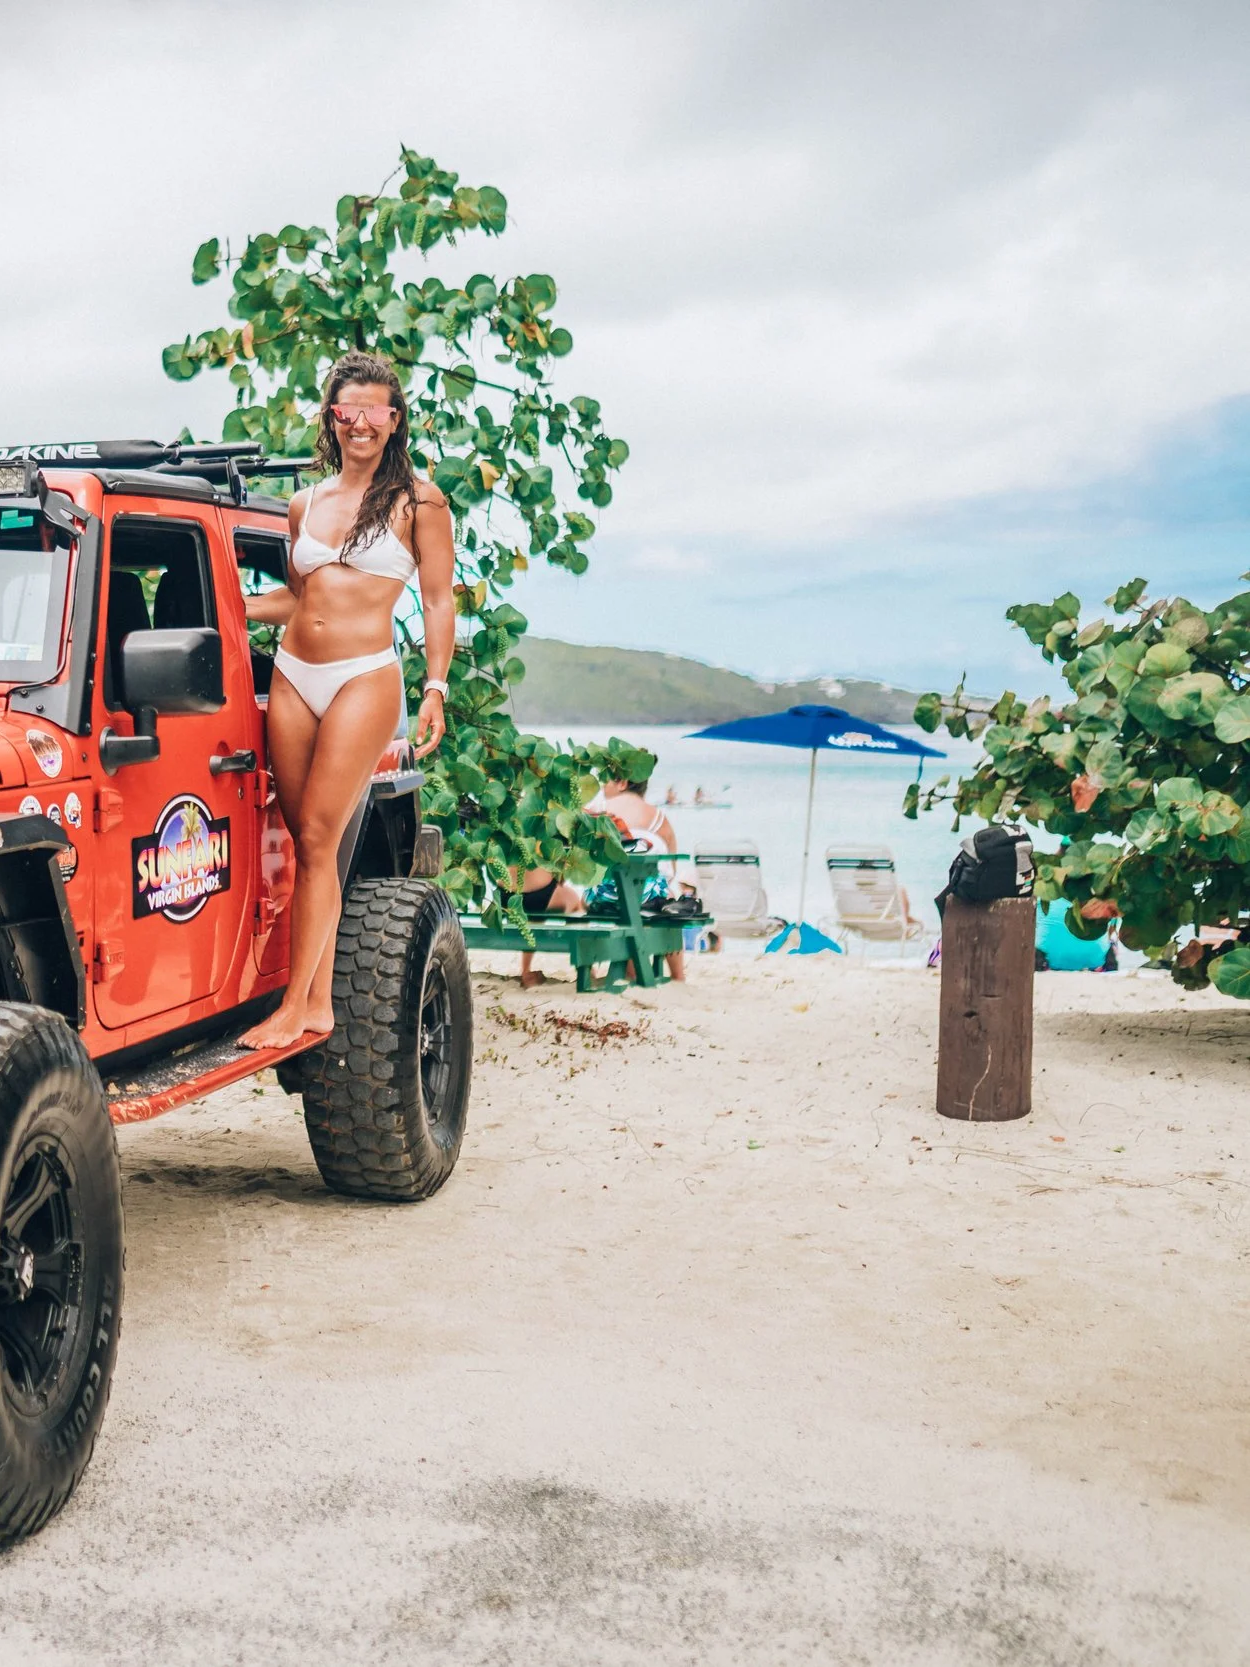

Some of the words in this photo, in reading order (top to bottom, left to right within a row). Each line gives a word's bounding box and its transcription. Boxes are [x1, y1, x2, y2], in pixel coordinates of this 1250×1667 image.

[137, 830, 228, 893] SUNFARI
[147, 883, 182, 911] VIRGIN
[184, 873, 219, 899] ISLANDS
